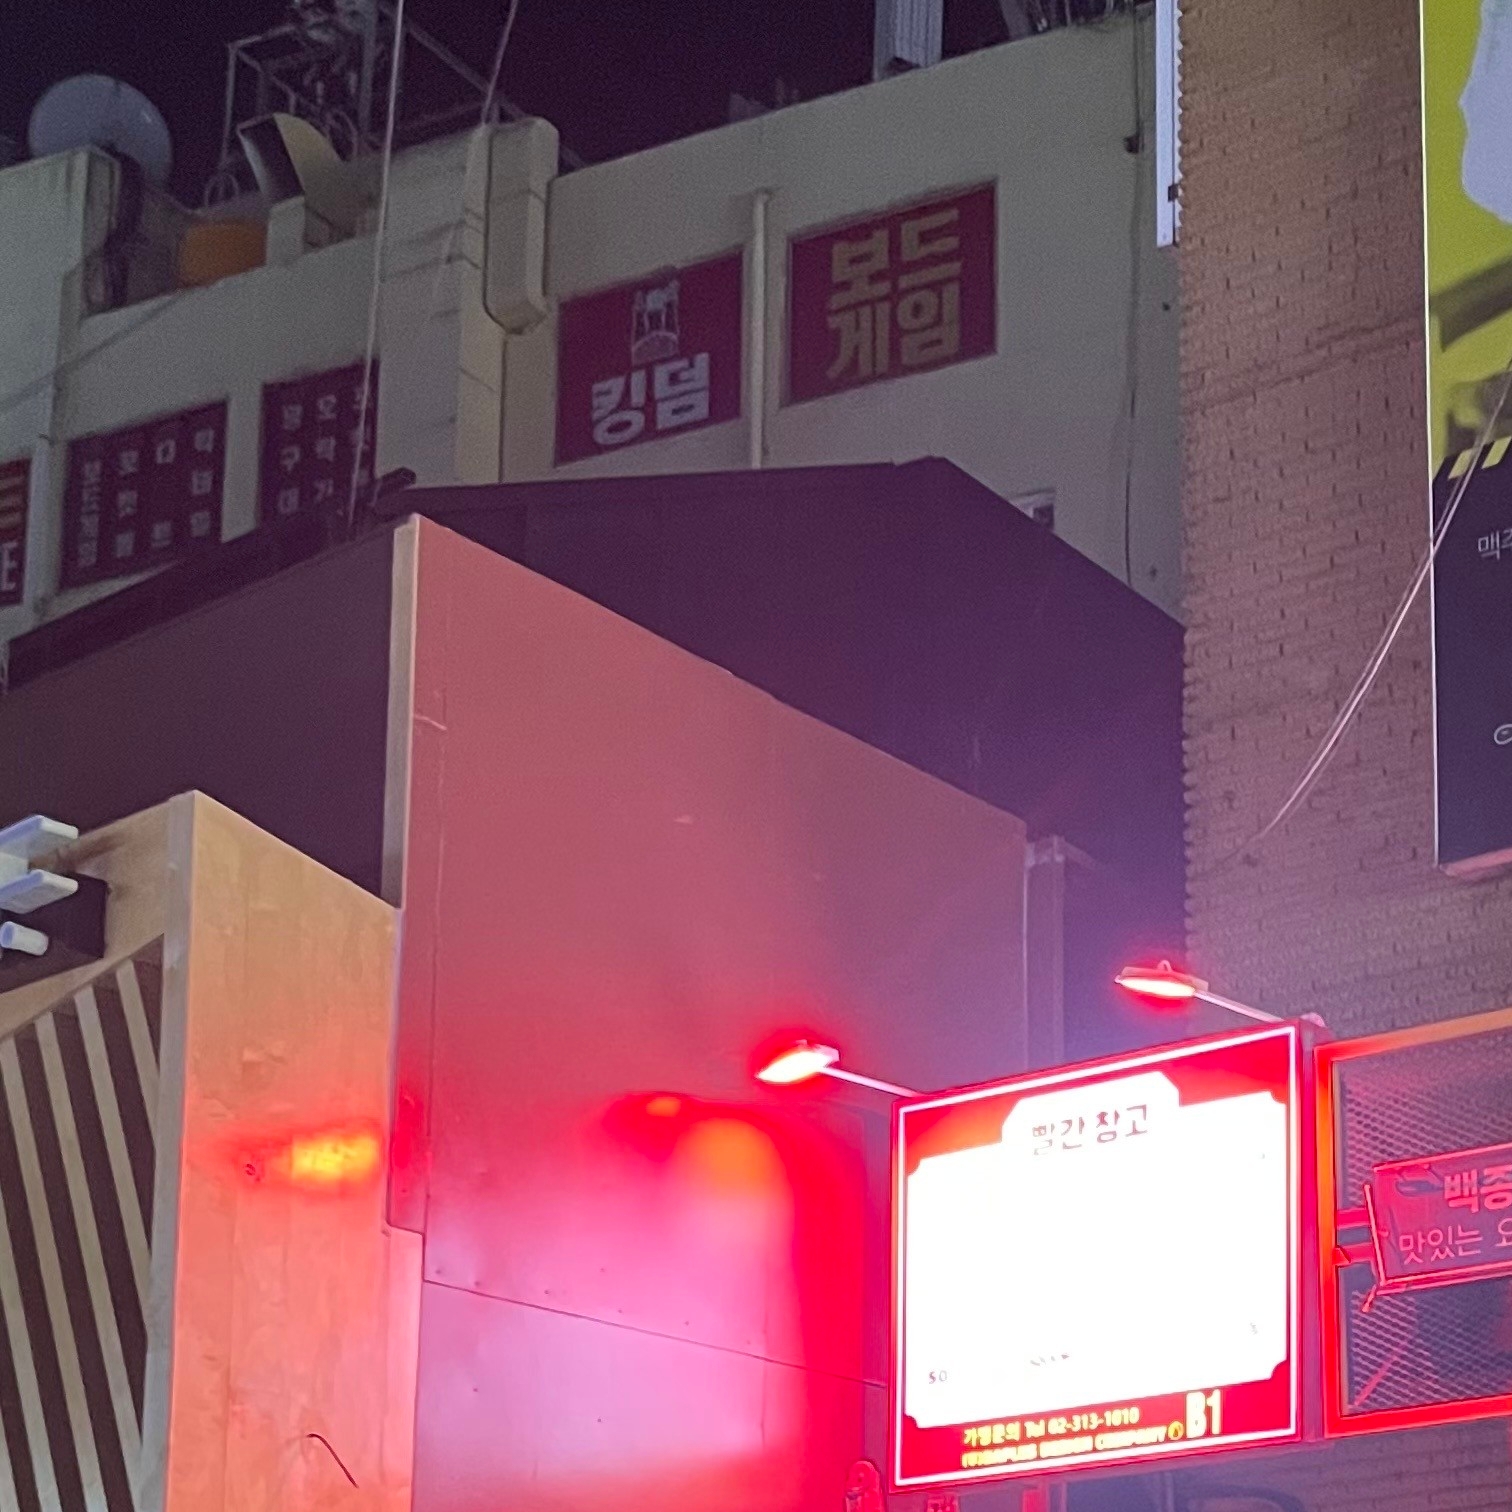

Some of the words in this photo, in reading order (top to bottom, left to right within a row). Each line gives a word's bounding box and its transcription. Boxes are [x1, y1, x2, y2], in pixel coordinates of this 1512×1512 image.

[830, 208, 961, 311] 보드
[826, 280, 961, 380] 게임
[591, 352, 710, 445] 킹덤
[1399, 1223, 1484, 1265] 맛있는
[1185, 1388, 1222, 1439] B1
